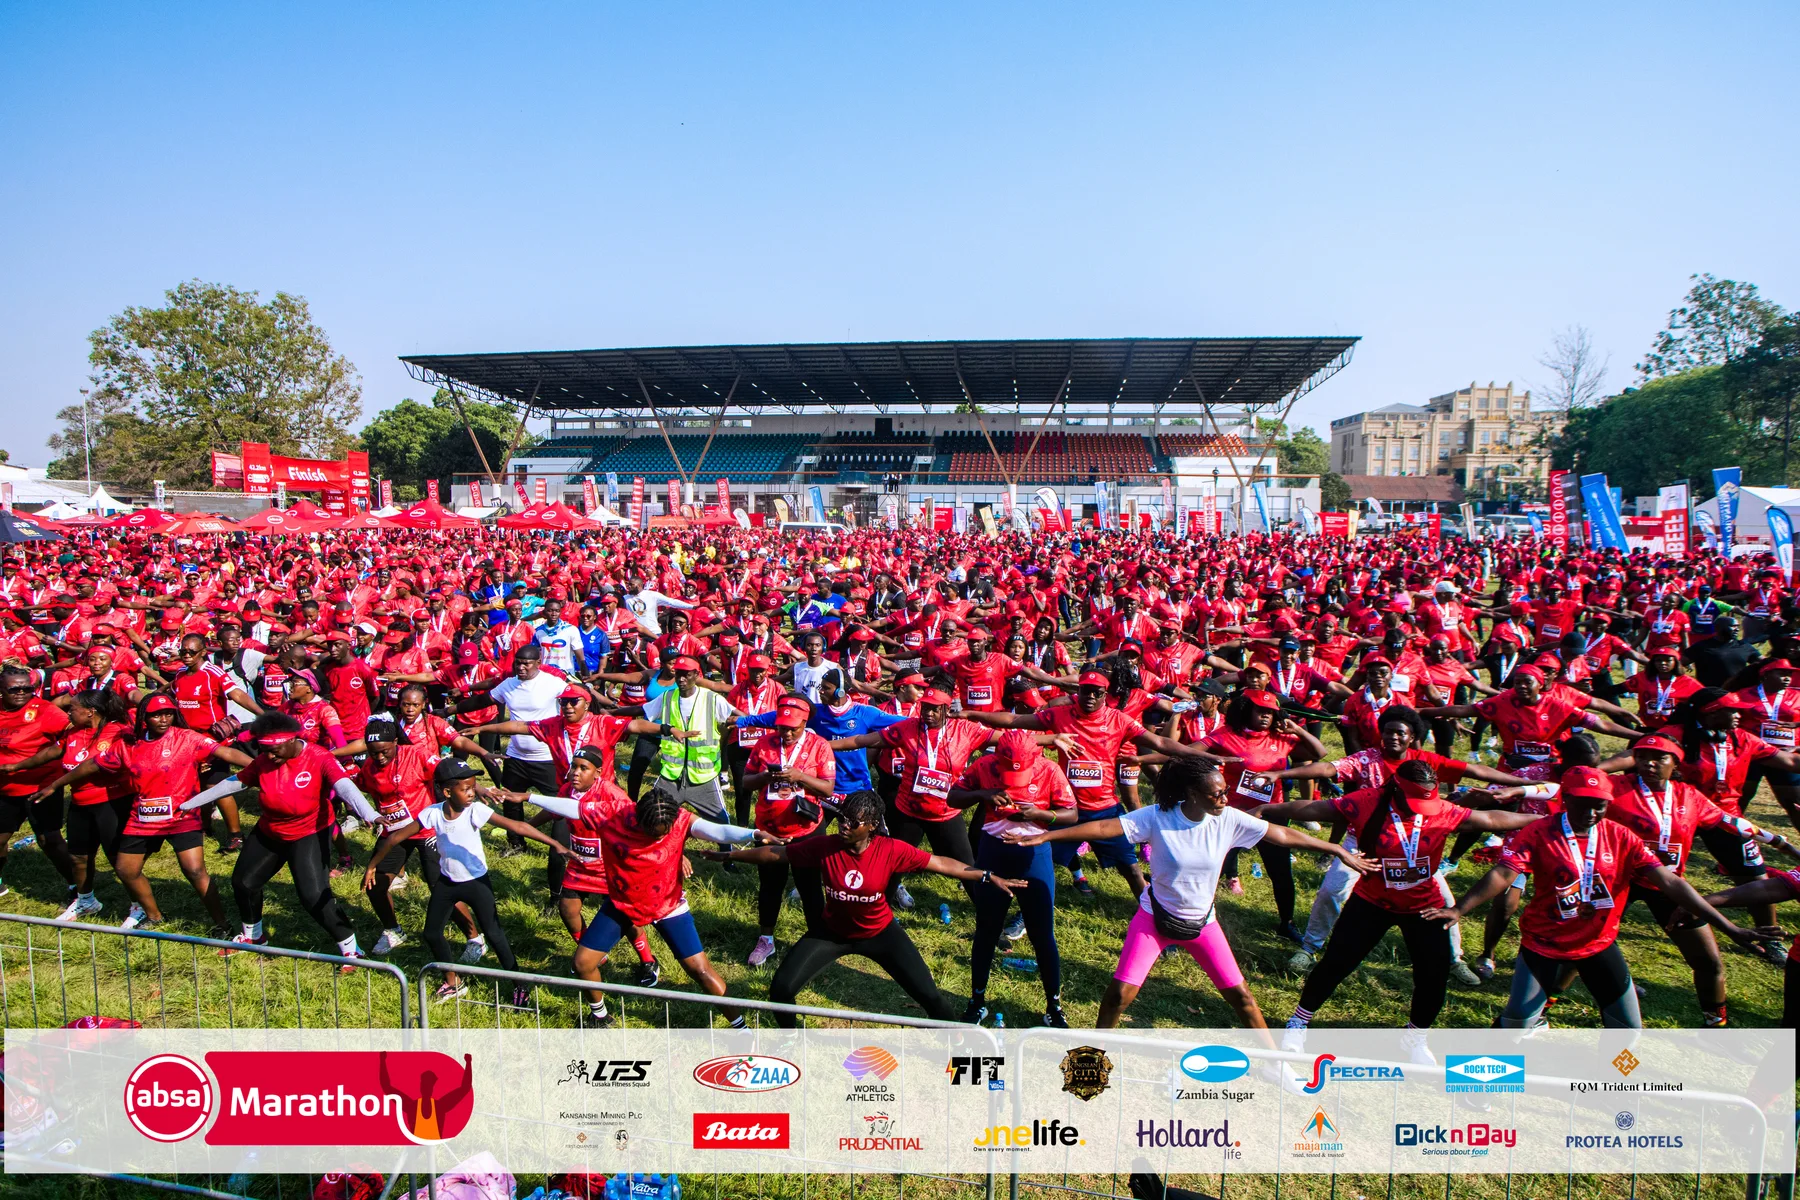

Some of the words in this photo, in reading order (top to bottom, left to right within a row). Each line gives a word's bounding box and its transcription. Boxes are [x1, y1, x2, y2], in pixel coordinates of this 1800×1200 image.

[287, 466, 328, 482] Finish
[1070, 768, 1100, 777] 102692
[921, 775, 946, 789] 50974
[139, 805, 169, 813] 100779
[386, 808, 407, 823] 2198
[825, 885, 883, 903] FitSmash
